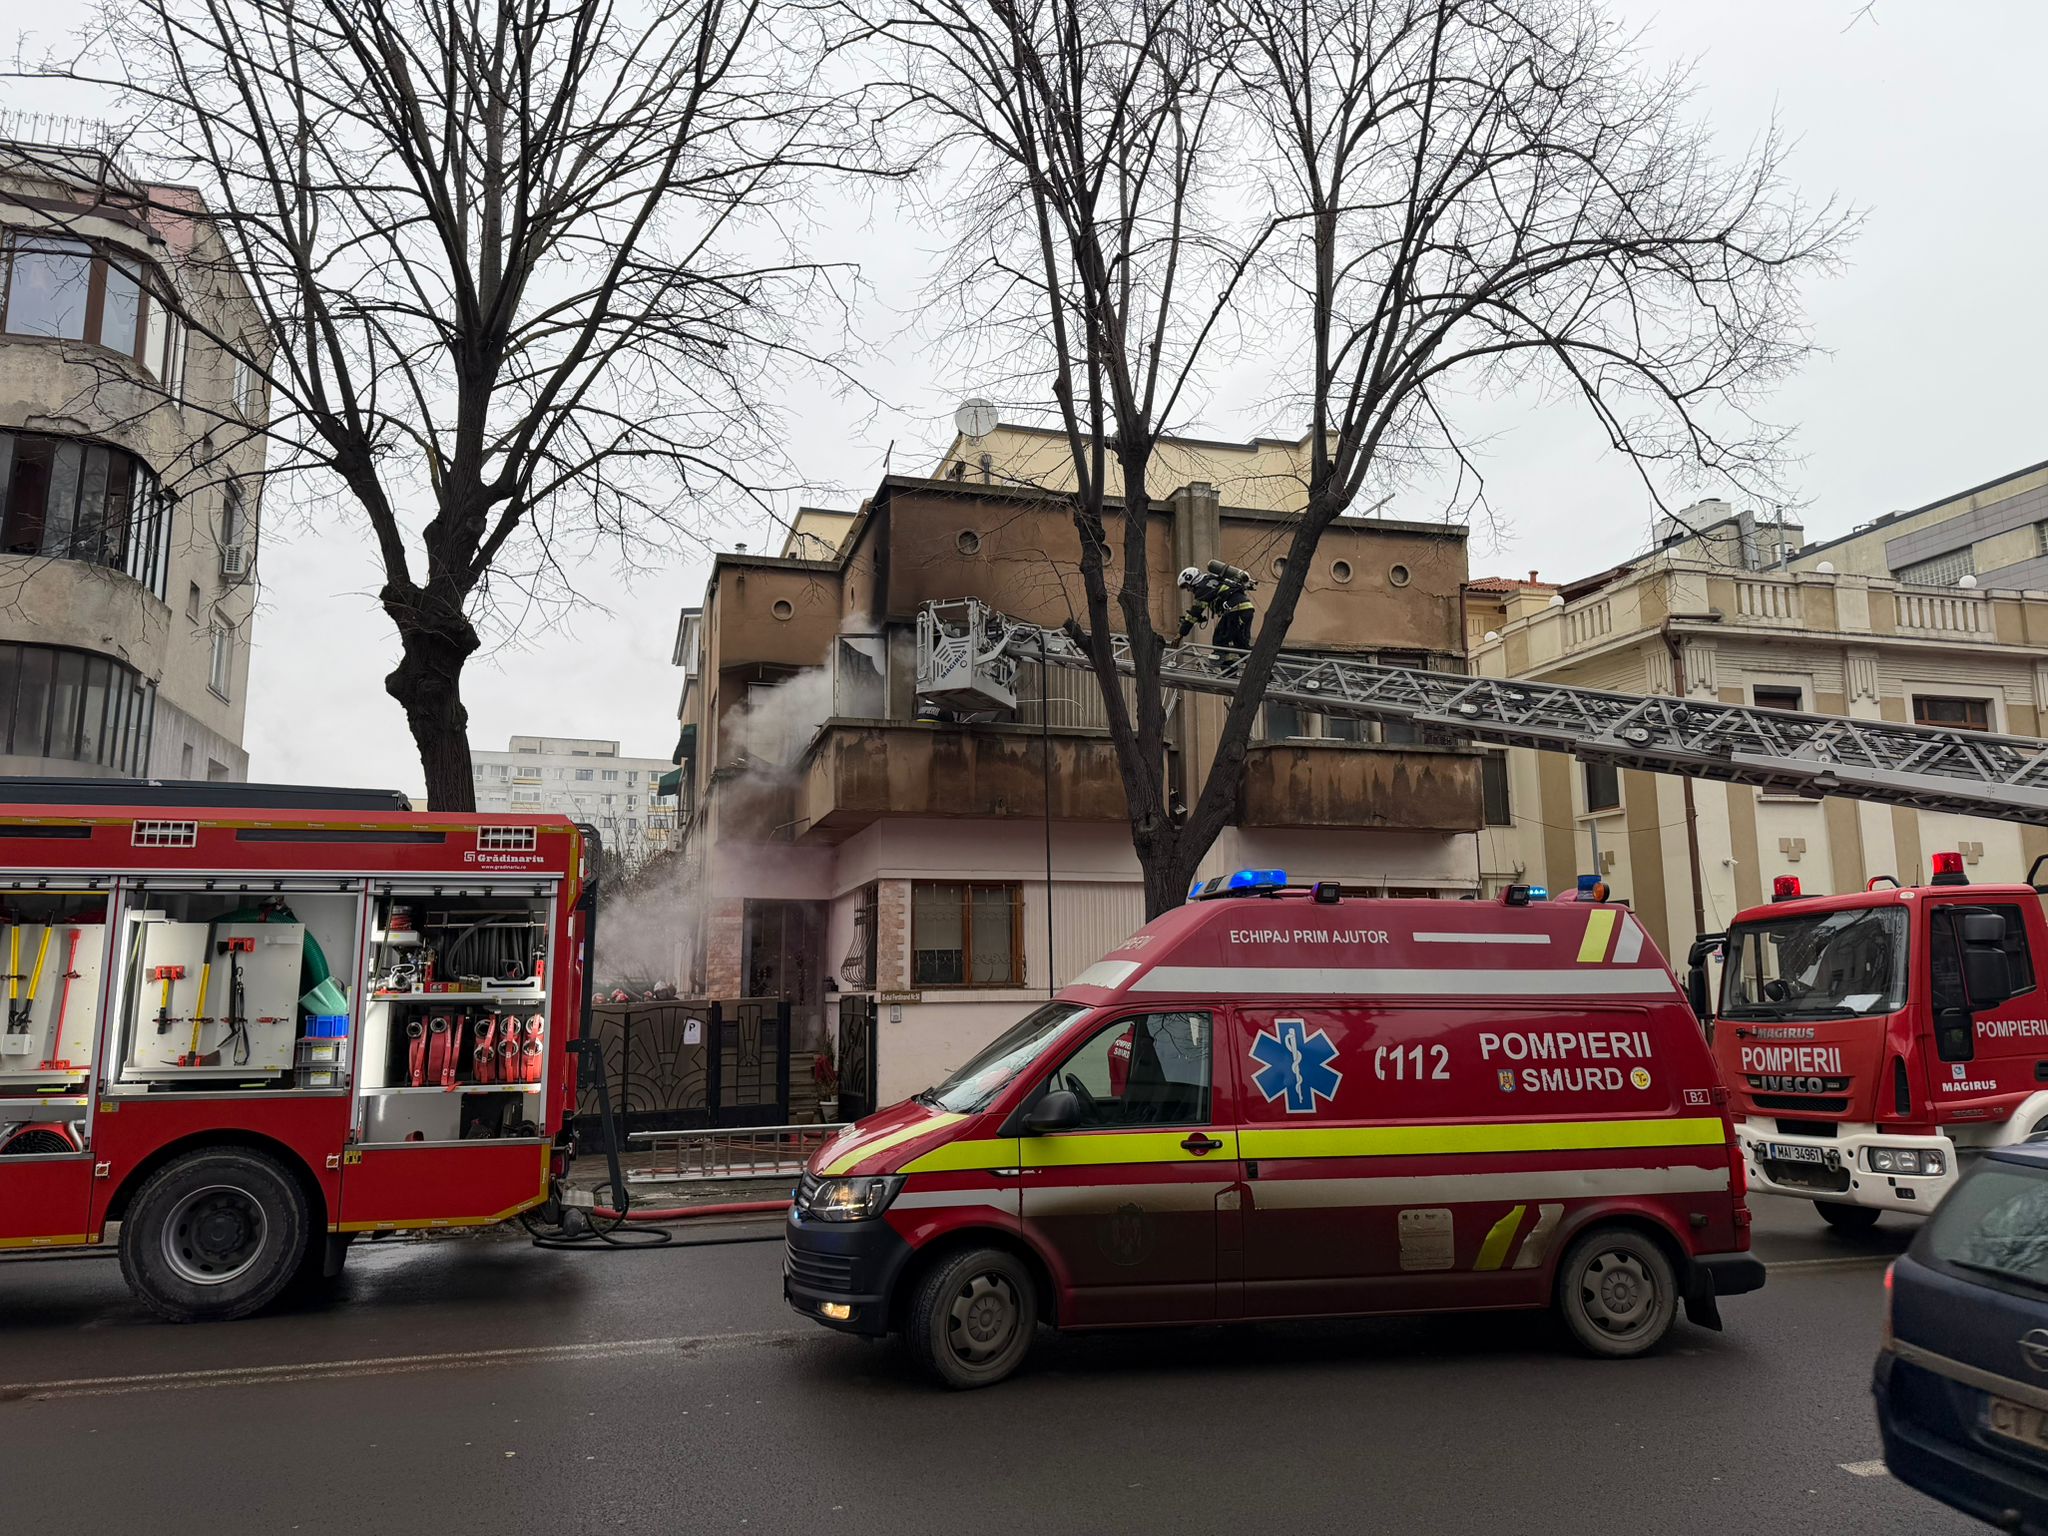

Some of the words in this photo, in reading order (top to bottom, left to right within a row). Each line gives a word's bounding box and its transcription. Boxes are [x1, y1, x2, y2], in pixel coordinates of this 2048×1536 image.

[477, 854, 544, 863] Grădinariu
[1230, 930, 1290, 944] ECHIPAJ
[1293, 930, 1329, 944] PRIM
[1332, 930, 1390, 944] AJUTOR
[689, 1022, 696, 1032] P
[1757, 1028, 1815, 1039] MAGIRUS
[1479, 1032, 1652, 1061] POMPIERII
[1389, 1044, 1450, 1080] 112
[1741, 1047, 1842, 1073] POMPIERII
[1521, 1067, 1624, 1092] SMURD
[1761, 1076, 1824, 1093] IVECO
[1942, 1080, 1997, 1092] MAGIRUS
[1690, 1092, 1704, 1103] B2
[1777, 1145, 1792, 1159] MAI
[1794, 1147, 1820, 1162] 34961
[1991, 1402, 2024, 1437] CT
